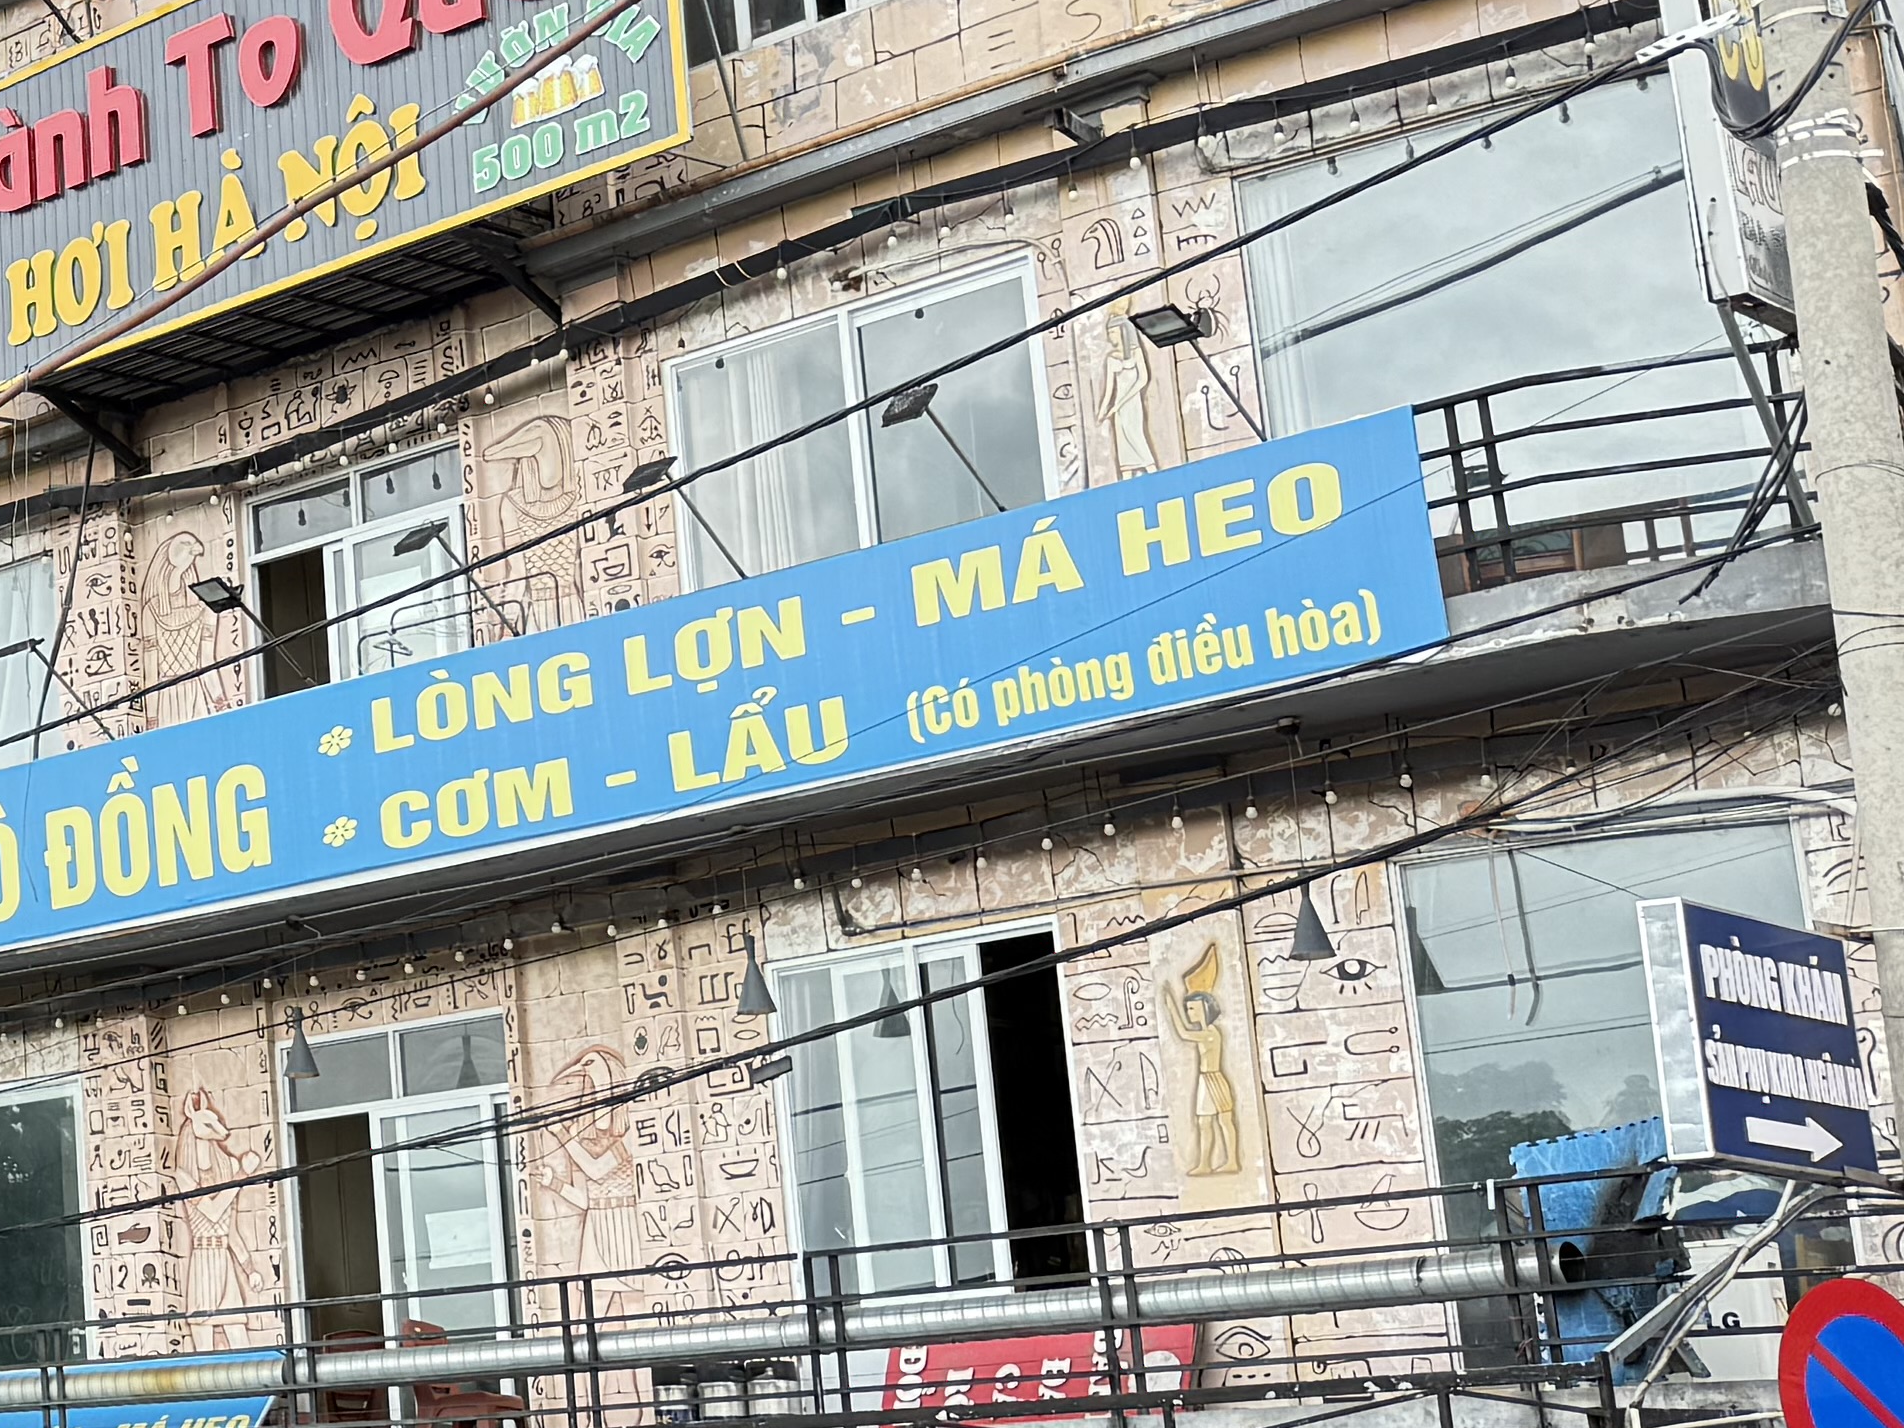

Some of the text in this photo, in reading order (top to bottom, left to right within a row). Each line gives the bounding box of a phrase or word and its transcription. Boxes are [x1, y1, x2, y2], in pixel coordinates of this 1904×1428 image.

[165, 12, 301, 136] To
[472, 90, 650, 193] 500 m2
[6, 219, 134, 345] HƠI
[149, 148, 265, 291] HÀ
[278, 94, 425, 242] NỘI
[371, 650, 592, 754] LÒNG
[624, 595, 807, 695] LỢN
[910, 515, 1084, 627] MÁ
[1116, 461, 1342, 576] HEO
[906, 588, 1382, 743] (Có phòng điều hòa)
[44, 756, 273, 910] ĐỒNG
[378, 758, 573, 850] CƠM
[669, 683, 849, 794] LẨU
[1700, 935, 1847, 1025] PHÒNG KHÁM
[1705, 1024, 1740, 1088] SẢN
